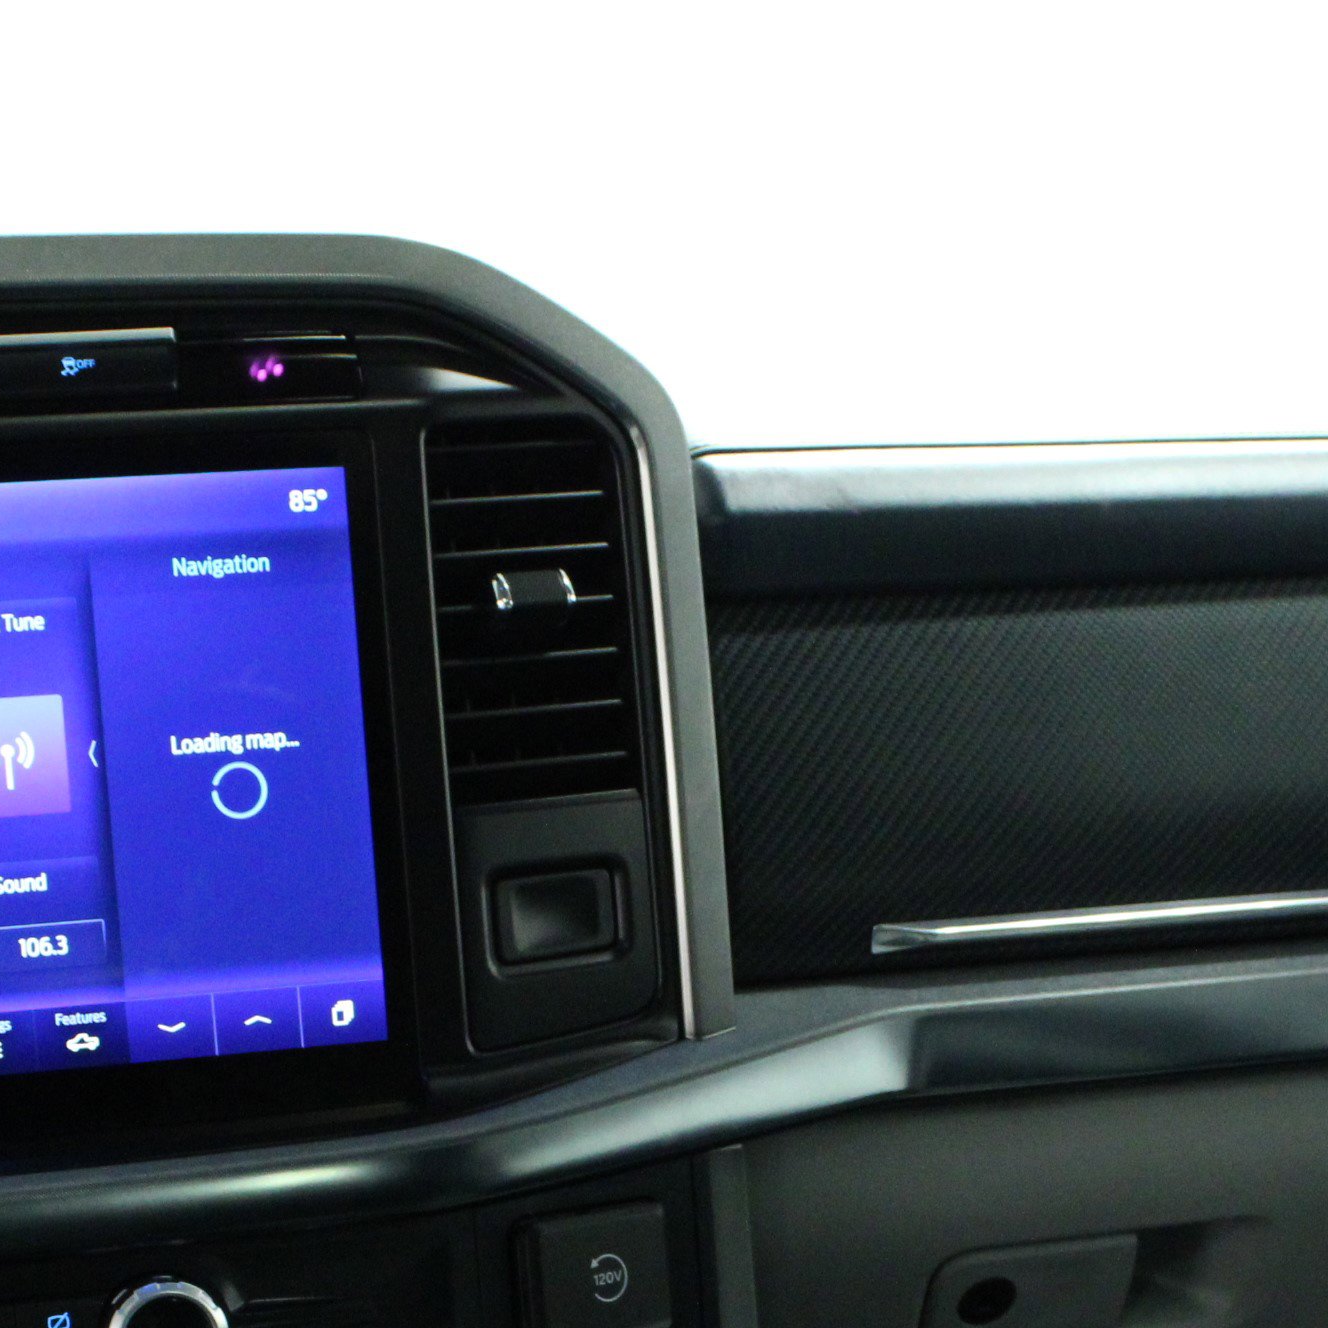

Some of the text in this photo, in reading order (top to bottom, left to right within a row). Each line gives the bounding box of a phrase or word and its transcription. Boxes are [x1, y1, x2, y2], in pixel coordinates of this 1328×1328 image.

[172, 553, 271, 579] Navigation
[2, 611, 46, 633] Tune
[170, 732, 245, 756] Loading
[18, 935, 70, 959] 106.3
[54, 1008, 107, 1027] Features
[593, 1270, 623, 1287] 120V
